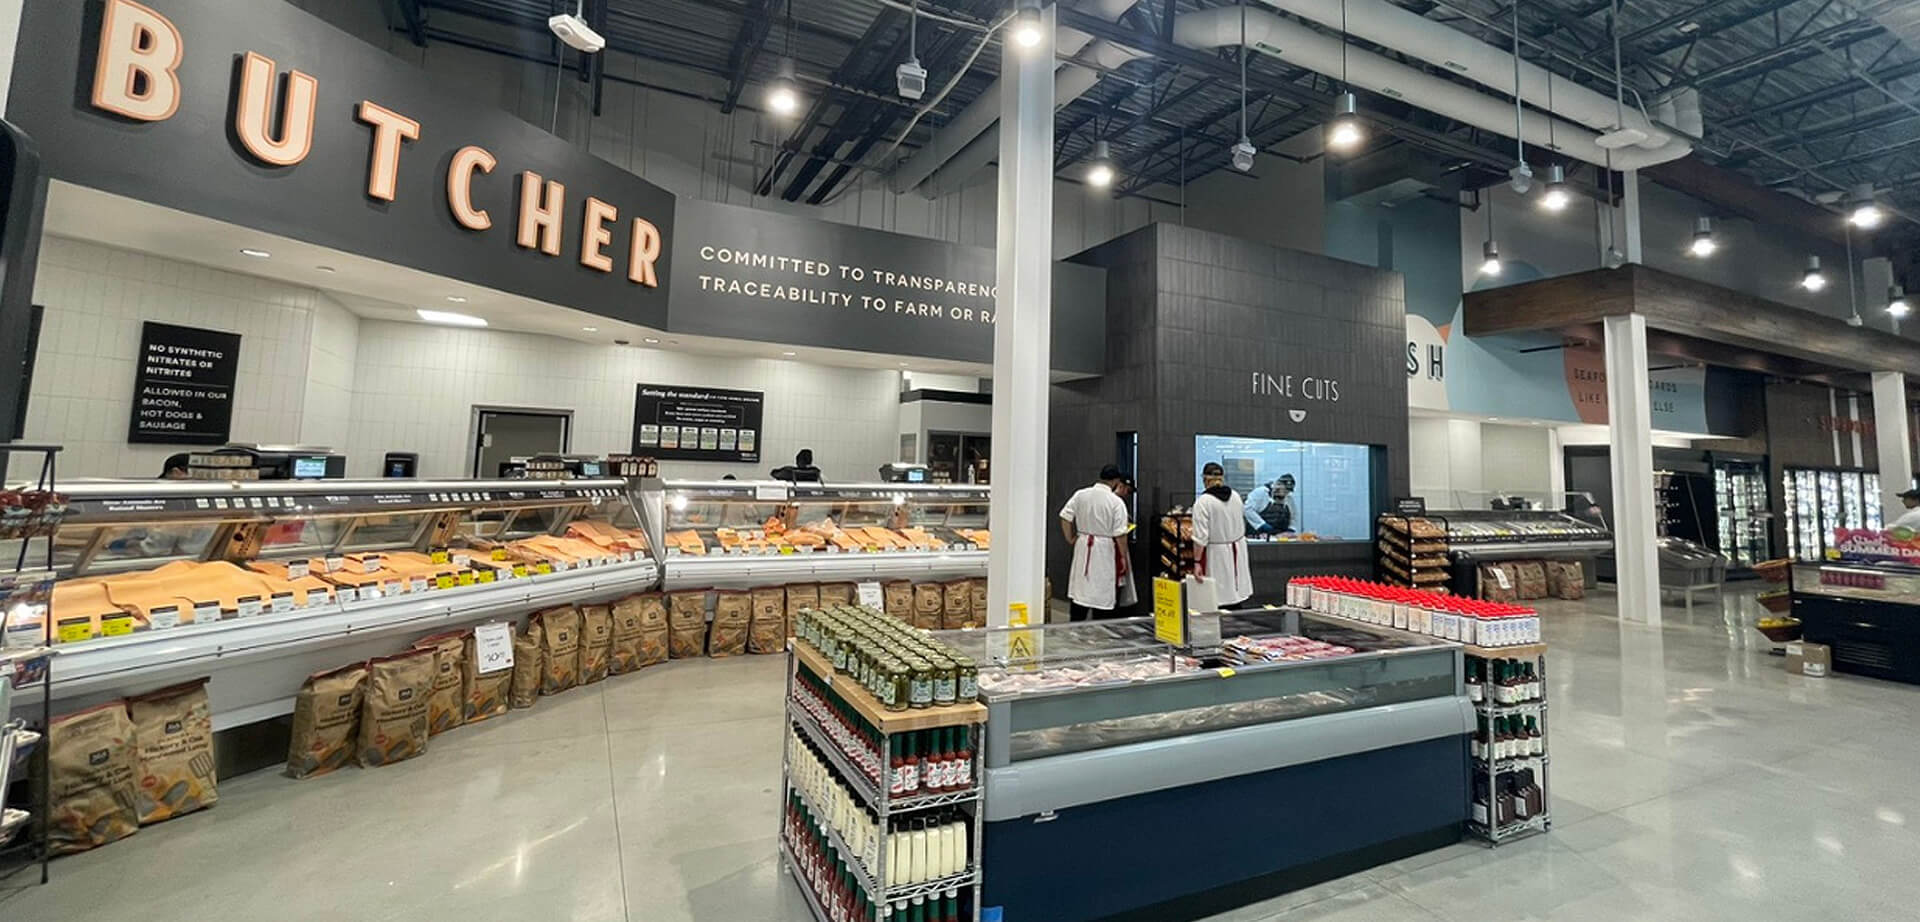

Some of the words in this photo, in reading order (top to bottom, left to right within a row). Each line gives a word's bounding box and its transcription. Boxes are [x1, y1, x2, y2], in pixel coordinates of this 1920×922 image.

[92, 0, 661, 288] BUTCHER
[700, 246, 830, 276] COMMITTED
[839, 265, 865, 281] TO
[699, 275, 852, 307] TRACEABILITY
[861, 296, 886, 311] TO
[895, 300, 943, 318] FARM
[951, 307, 973, 321] OR
[149, 344, 165, 353] NO
[168, 346, 223, 359] SYNTHETIC
[147, 355, 197, 368] NITRATES
[199, 360, 213, 369] OR
[146, 366, 192, 378] NITRITES
[143, 386, 193, 398] ALLOWED
[194, 391, 205, 399] IN
[207, 391, 227, 400] OUR
[1253, 371, 1293, 398] FINE
[1302, 377, 1340, 402] CUTS
[142, 398, 182, 409] BACON,
[1653, 400, 1674, 413] ELSE
[140, 409, 162, 419] HOT
[165, 411, 193, 420] DOGS
[196, 412, 203, 420] &
[139, 420, 187, 431] SAUSAGE
[1840, 543, 1900, 557] SUMMER
